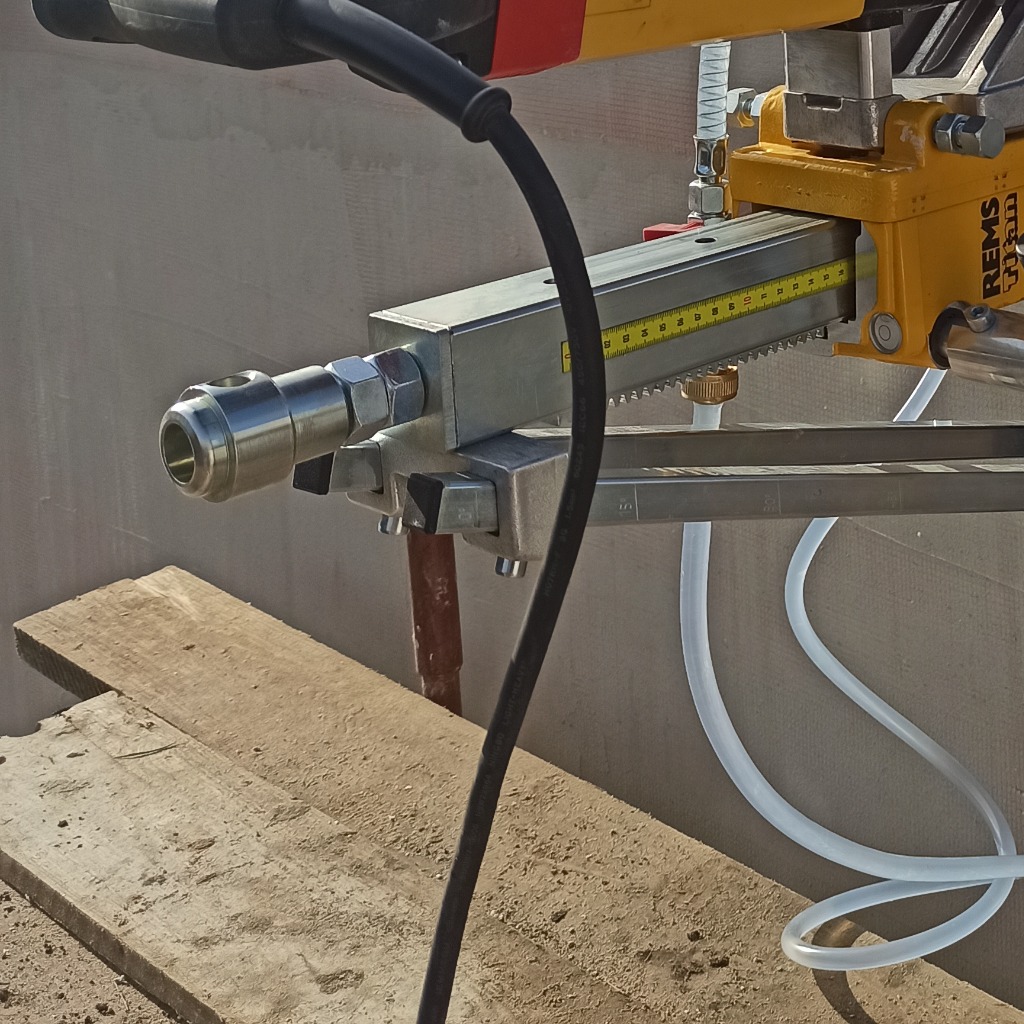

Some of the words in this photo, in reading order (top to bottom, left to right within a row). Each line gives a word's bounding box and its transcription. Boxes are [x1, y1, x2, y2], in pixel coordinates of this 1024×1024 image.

[981, 197, 1000, 299] REMS
[1002, 192, 1018, 293] Titan
[641, 328, 648, 337] 04
[659, 323, 666, 331] 05
[677, 317, 684, 326] 06
[711, 307, 719, 316] 08
[728, 302, 735, 310] 09
[744, 296, 751, 306] 10
[777, 287, 784, 295] 12
[792, 282, 799, 290] 13
[808, 278, 814, 286] 14
[824, 273, 829, 281] 15
